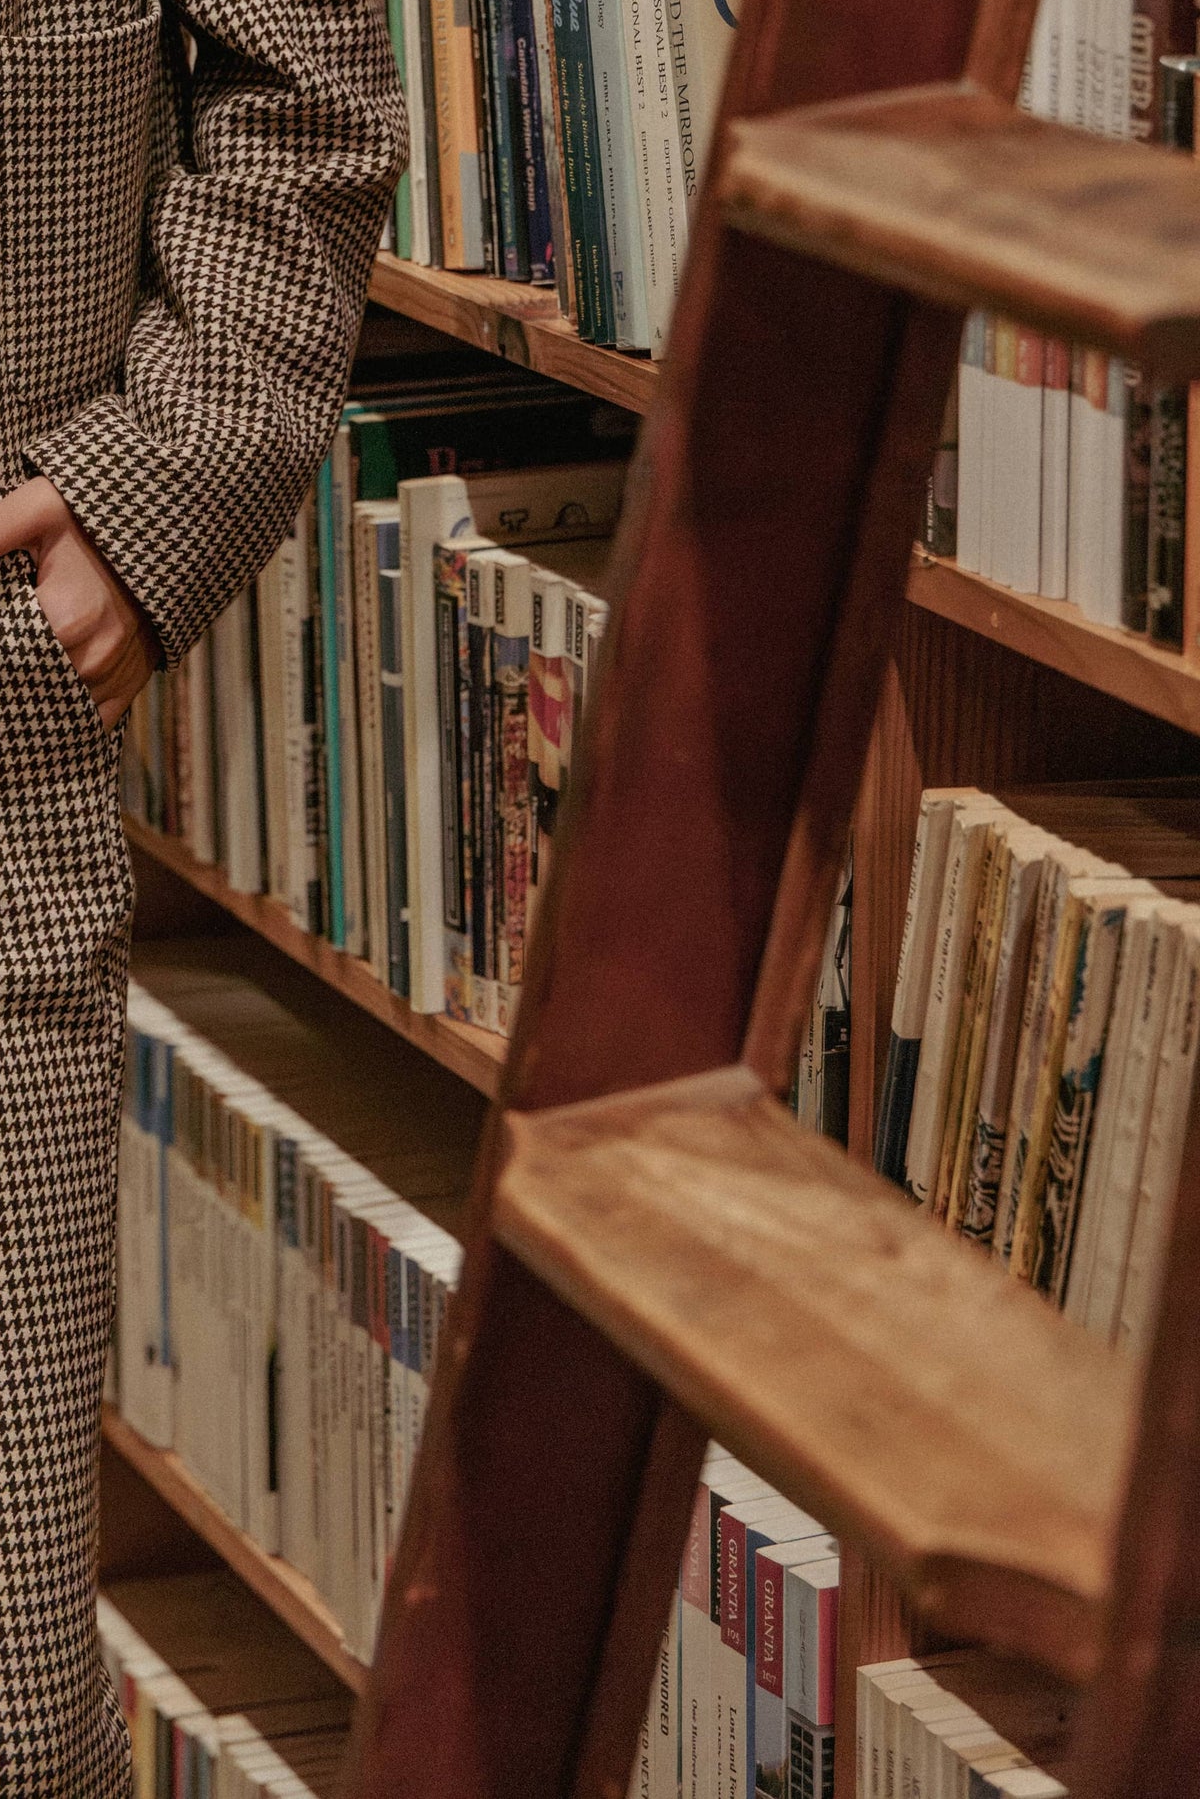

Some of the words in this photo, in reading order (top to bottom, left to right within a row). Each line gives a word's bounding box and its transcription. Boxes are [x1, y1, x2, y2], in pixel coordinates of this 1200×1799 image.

[672, 23, 687, 77] THE
[576, 61, 586, 104] Selected
[635, 54, 645, 98] BEST
[657, 61, 668, 105] BEST
[559, 57, 569, 97] Selected
[564, 114, 573, 153] Richard
[638, 102, 645, 110] 2
[661, 110, 668, 119] 2
[580, 119, 590, 158] Richard
[677, 82, 698, 199] MIRRORS
[663, 138, 672, 185] EDITED
[666, 187, 673, 203] BY
[643, 178, 649, 195] BY
[649, 242, 657, 289] DISHER
[668, 206, 676, 248] GARRY
[727, 1537, 738, 1621] GRANTA
[763, 1578, 775, 1663] GRANTA
[659, 1650, 670, 1737] HUNDRED
[729, 1706, 737, 1739] Lost
[729, 1742, 737, 1773] and
